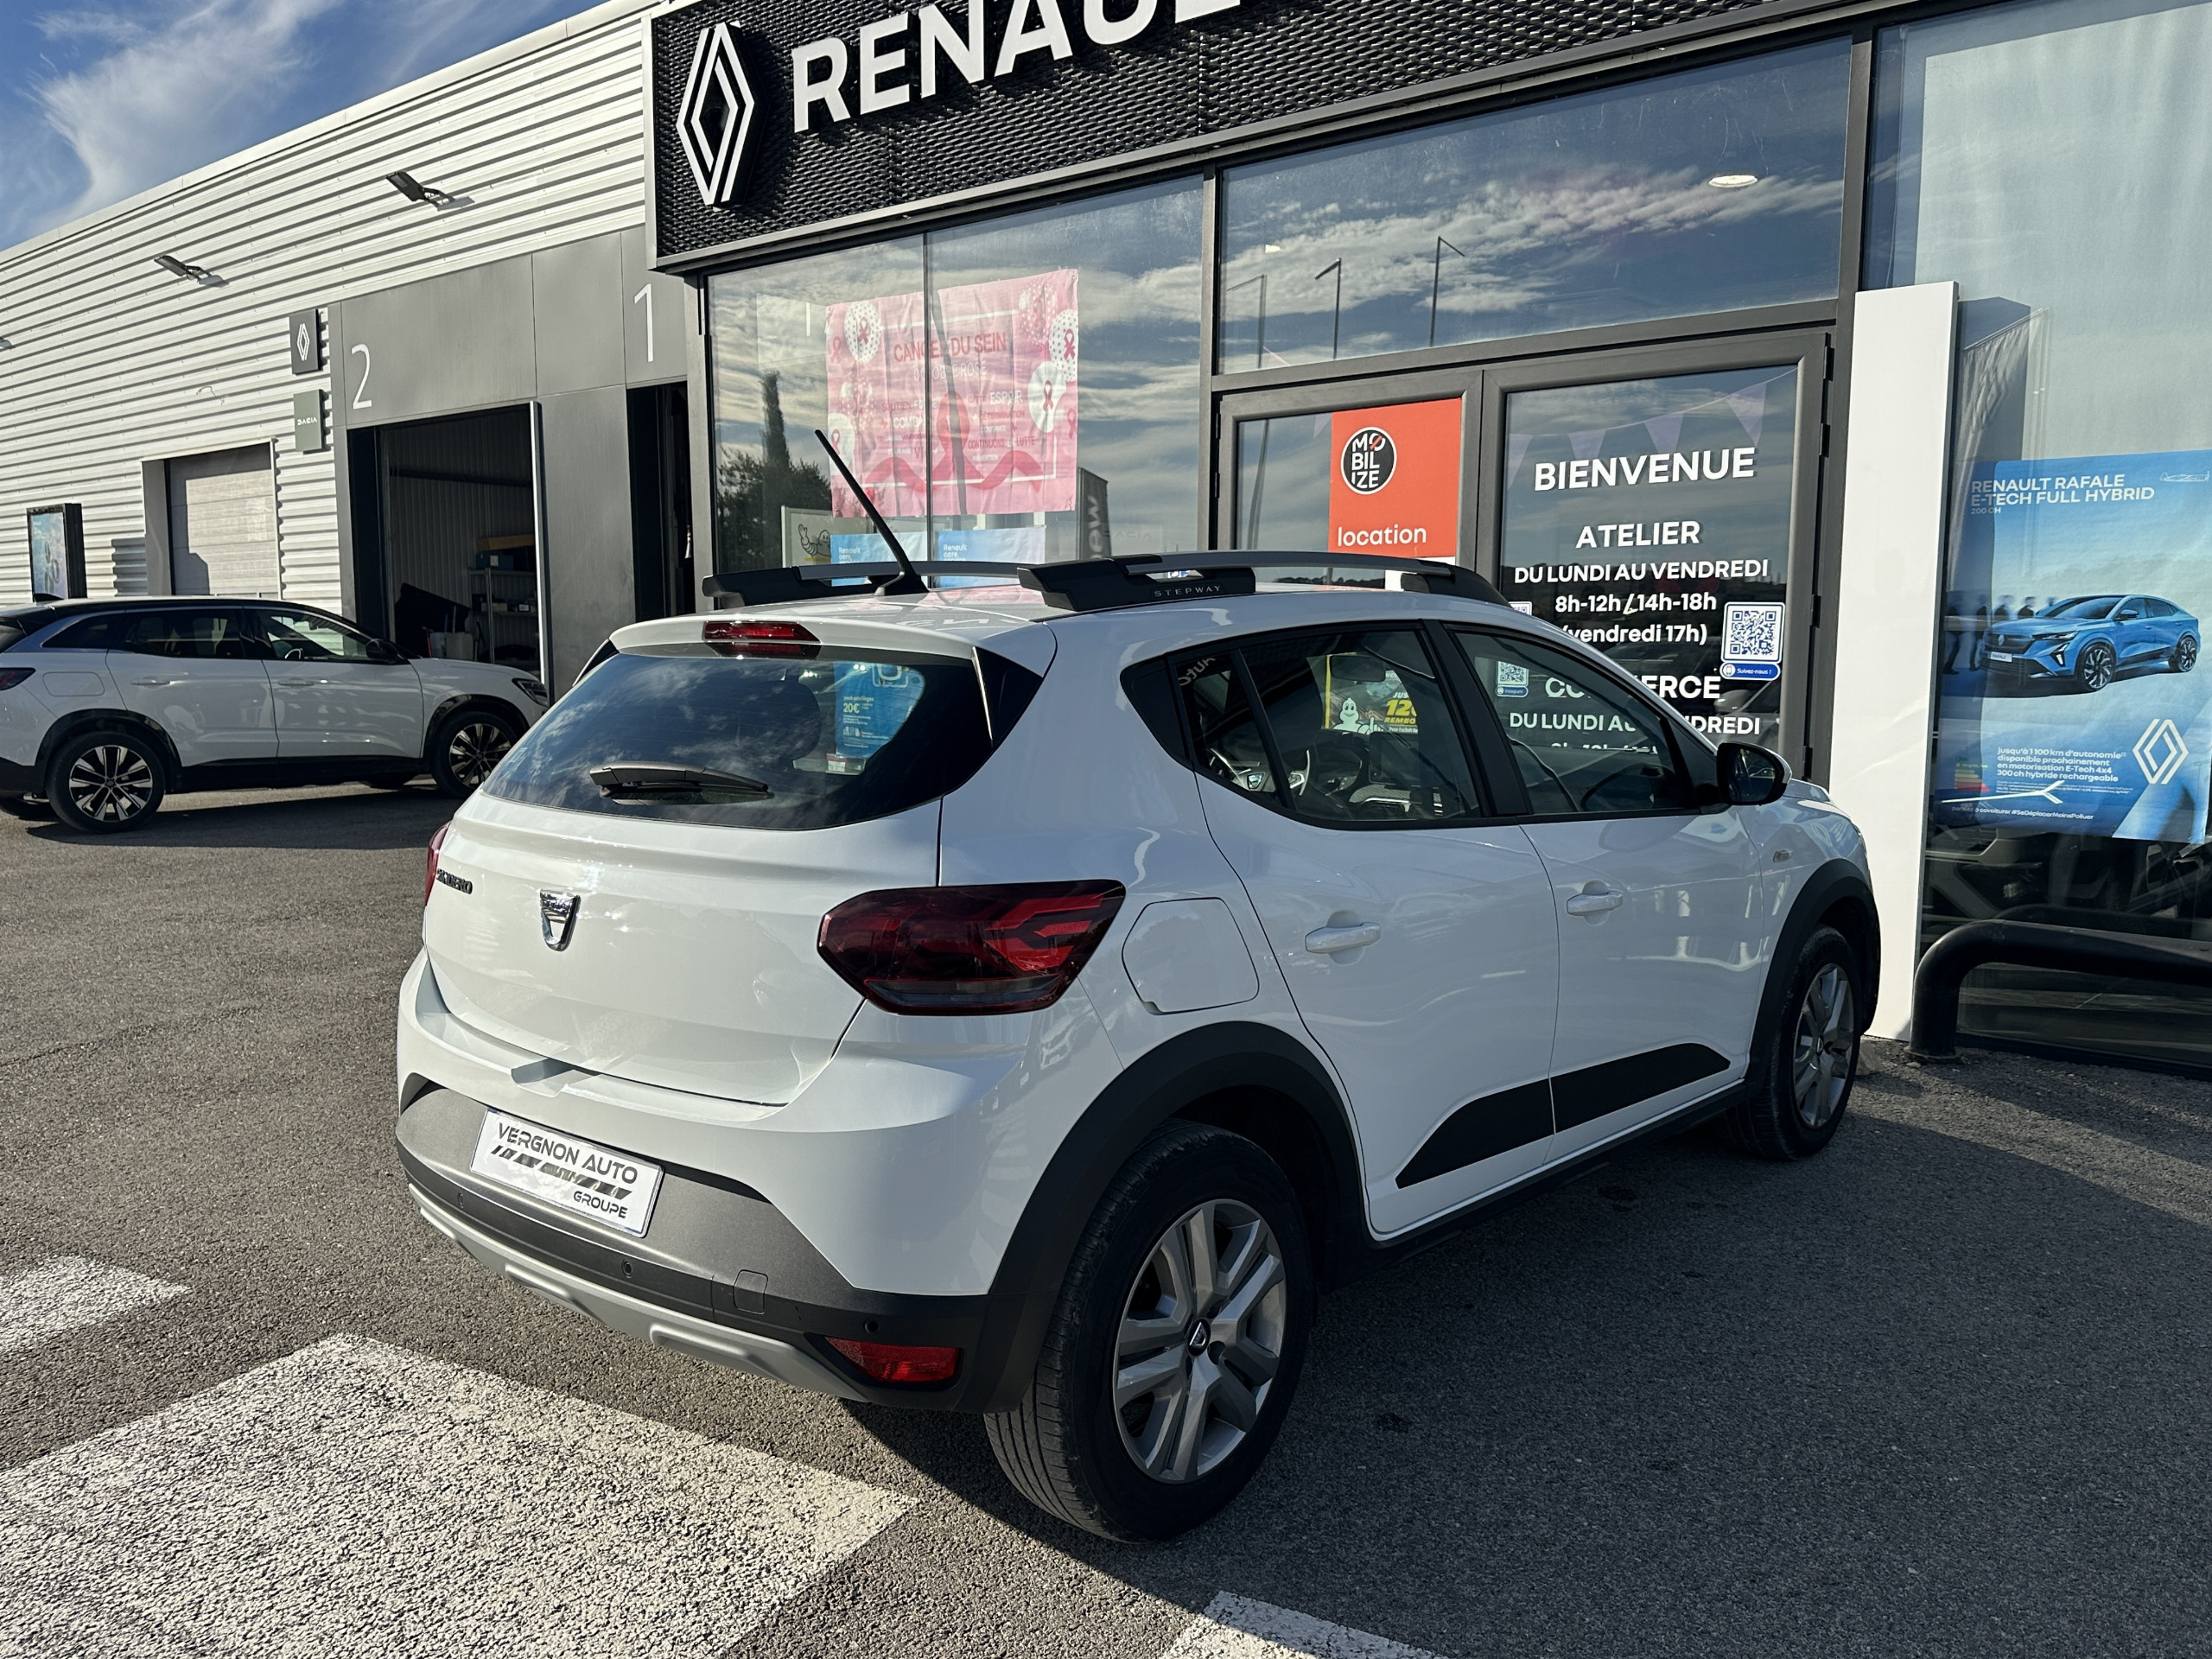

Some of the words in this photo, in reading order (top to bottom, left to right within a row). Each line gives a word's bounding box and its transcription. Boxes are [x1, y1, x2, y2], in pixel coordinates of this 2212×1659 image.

[791, 0, 1241, 132] RENA
[634, 283, 654, 362] 1
[894, 339, 944, 362] CANE
[950, 335, 970, 357] DU
[974, 332, 1007, 353] SEIN
[352, 344, 373, 410] 2
[960, 361, 988, 378] ROSE
[297, 416, 318, 426] DACIA
[893, 416, 923, 429] COMBA
[1016, 435, 1036, 447] LUTTE
[1535, 447, 1756, 492] BIENVENUE
[1972, 478, 2052, 493] RENAULT
[2055, 474, 2125, 490] RAFALE
[1971, 493, 2032, 507] E-TECH
[2036, 490, 2081, 505] FULL
[2085, 486, 2155, 502] HYBRID
[1338, 524, 1427, 546] location
[1575, 520, 1700, 549] ATELIER
[1514, 567, 1543, 583] DU
[1548, 564, 1611, 582] LUNDI
[1614, 563, 1645, 581] AU
[1650, 559, 1768, 580] VENDREDI
[1154, 585, 1221, 597] STEPWAY
[1665, 624, 1707, 645] 17h)
[1546, 677, 1720, 699] CERCE
[1510, 712, 1538, 729] DU
[1541, 714, 1604, 731] LUNDI
[1685, 716, 1760, 734] DREDI
[1997, 754, 2041, 763] disponible
[2042, 757, 2110, 766] prochainement
[2009, 763, 2064, 772] motorisation
[2065, 765, 2094, 773] E-Tech
[2025, 771, 2058, 779] hybride
[2059, 772, 2119, 782] rechargeable
[499, 1122, 580, 1166] VERGNON
[581, 1154, 639, 1185] AUTO
[573, 1191, 628, 1219] GROUPE
